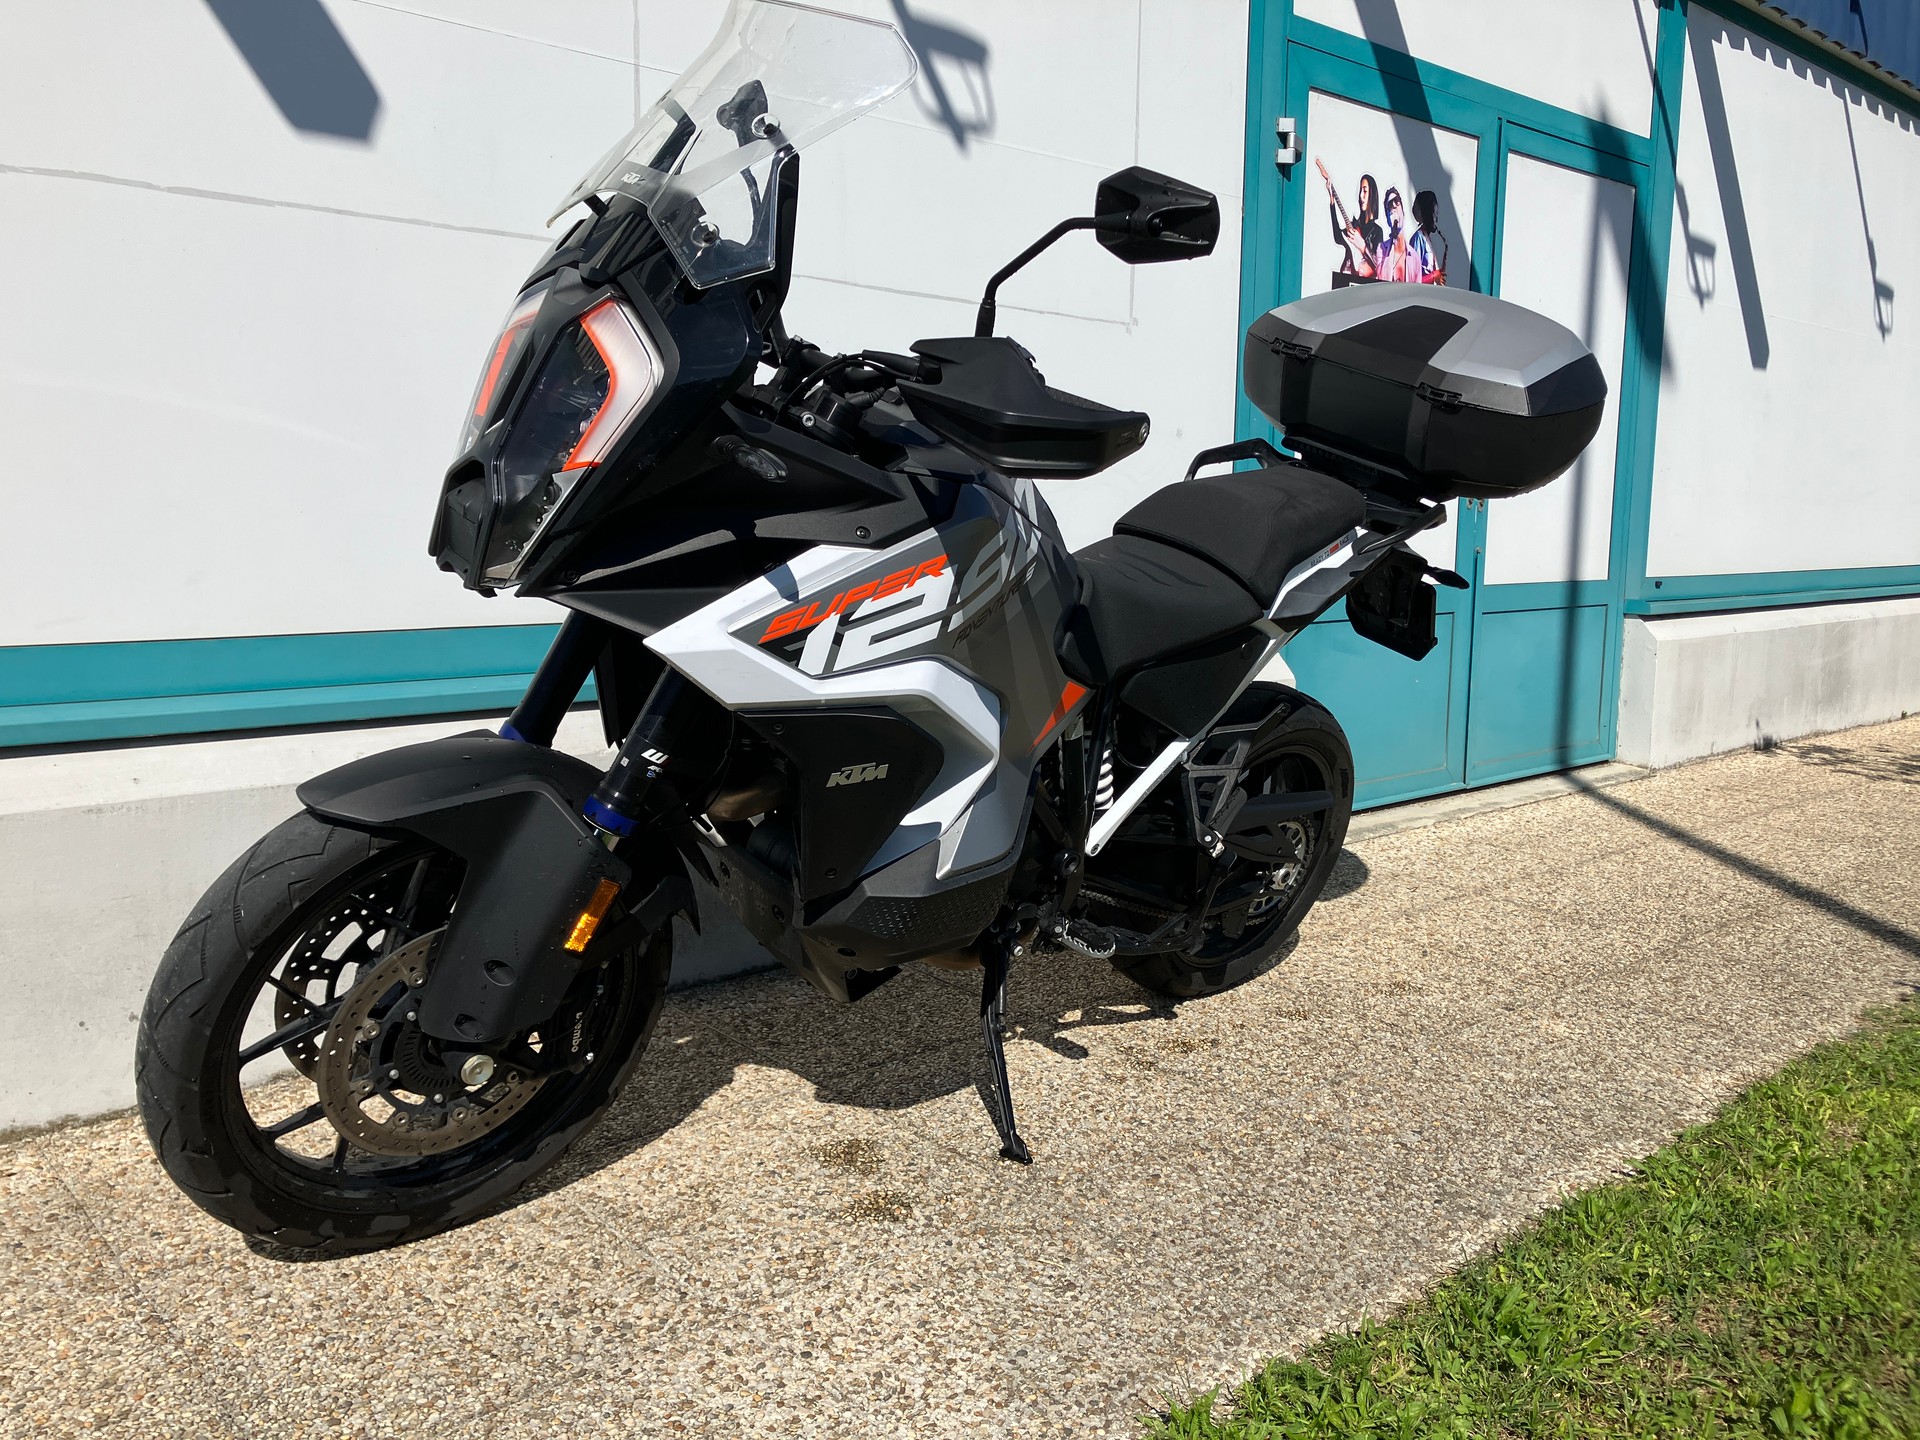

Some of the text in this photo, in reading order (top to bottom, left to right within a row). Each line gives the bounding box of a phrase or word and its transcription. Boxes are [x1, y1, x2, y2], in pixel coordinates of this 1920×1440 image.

[620, 171, 642, 185] KTM
[758, 554, 950, 645] SUPER
[825, 762, 889, 788] KTM
